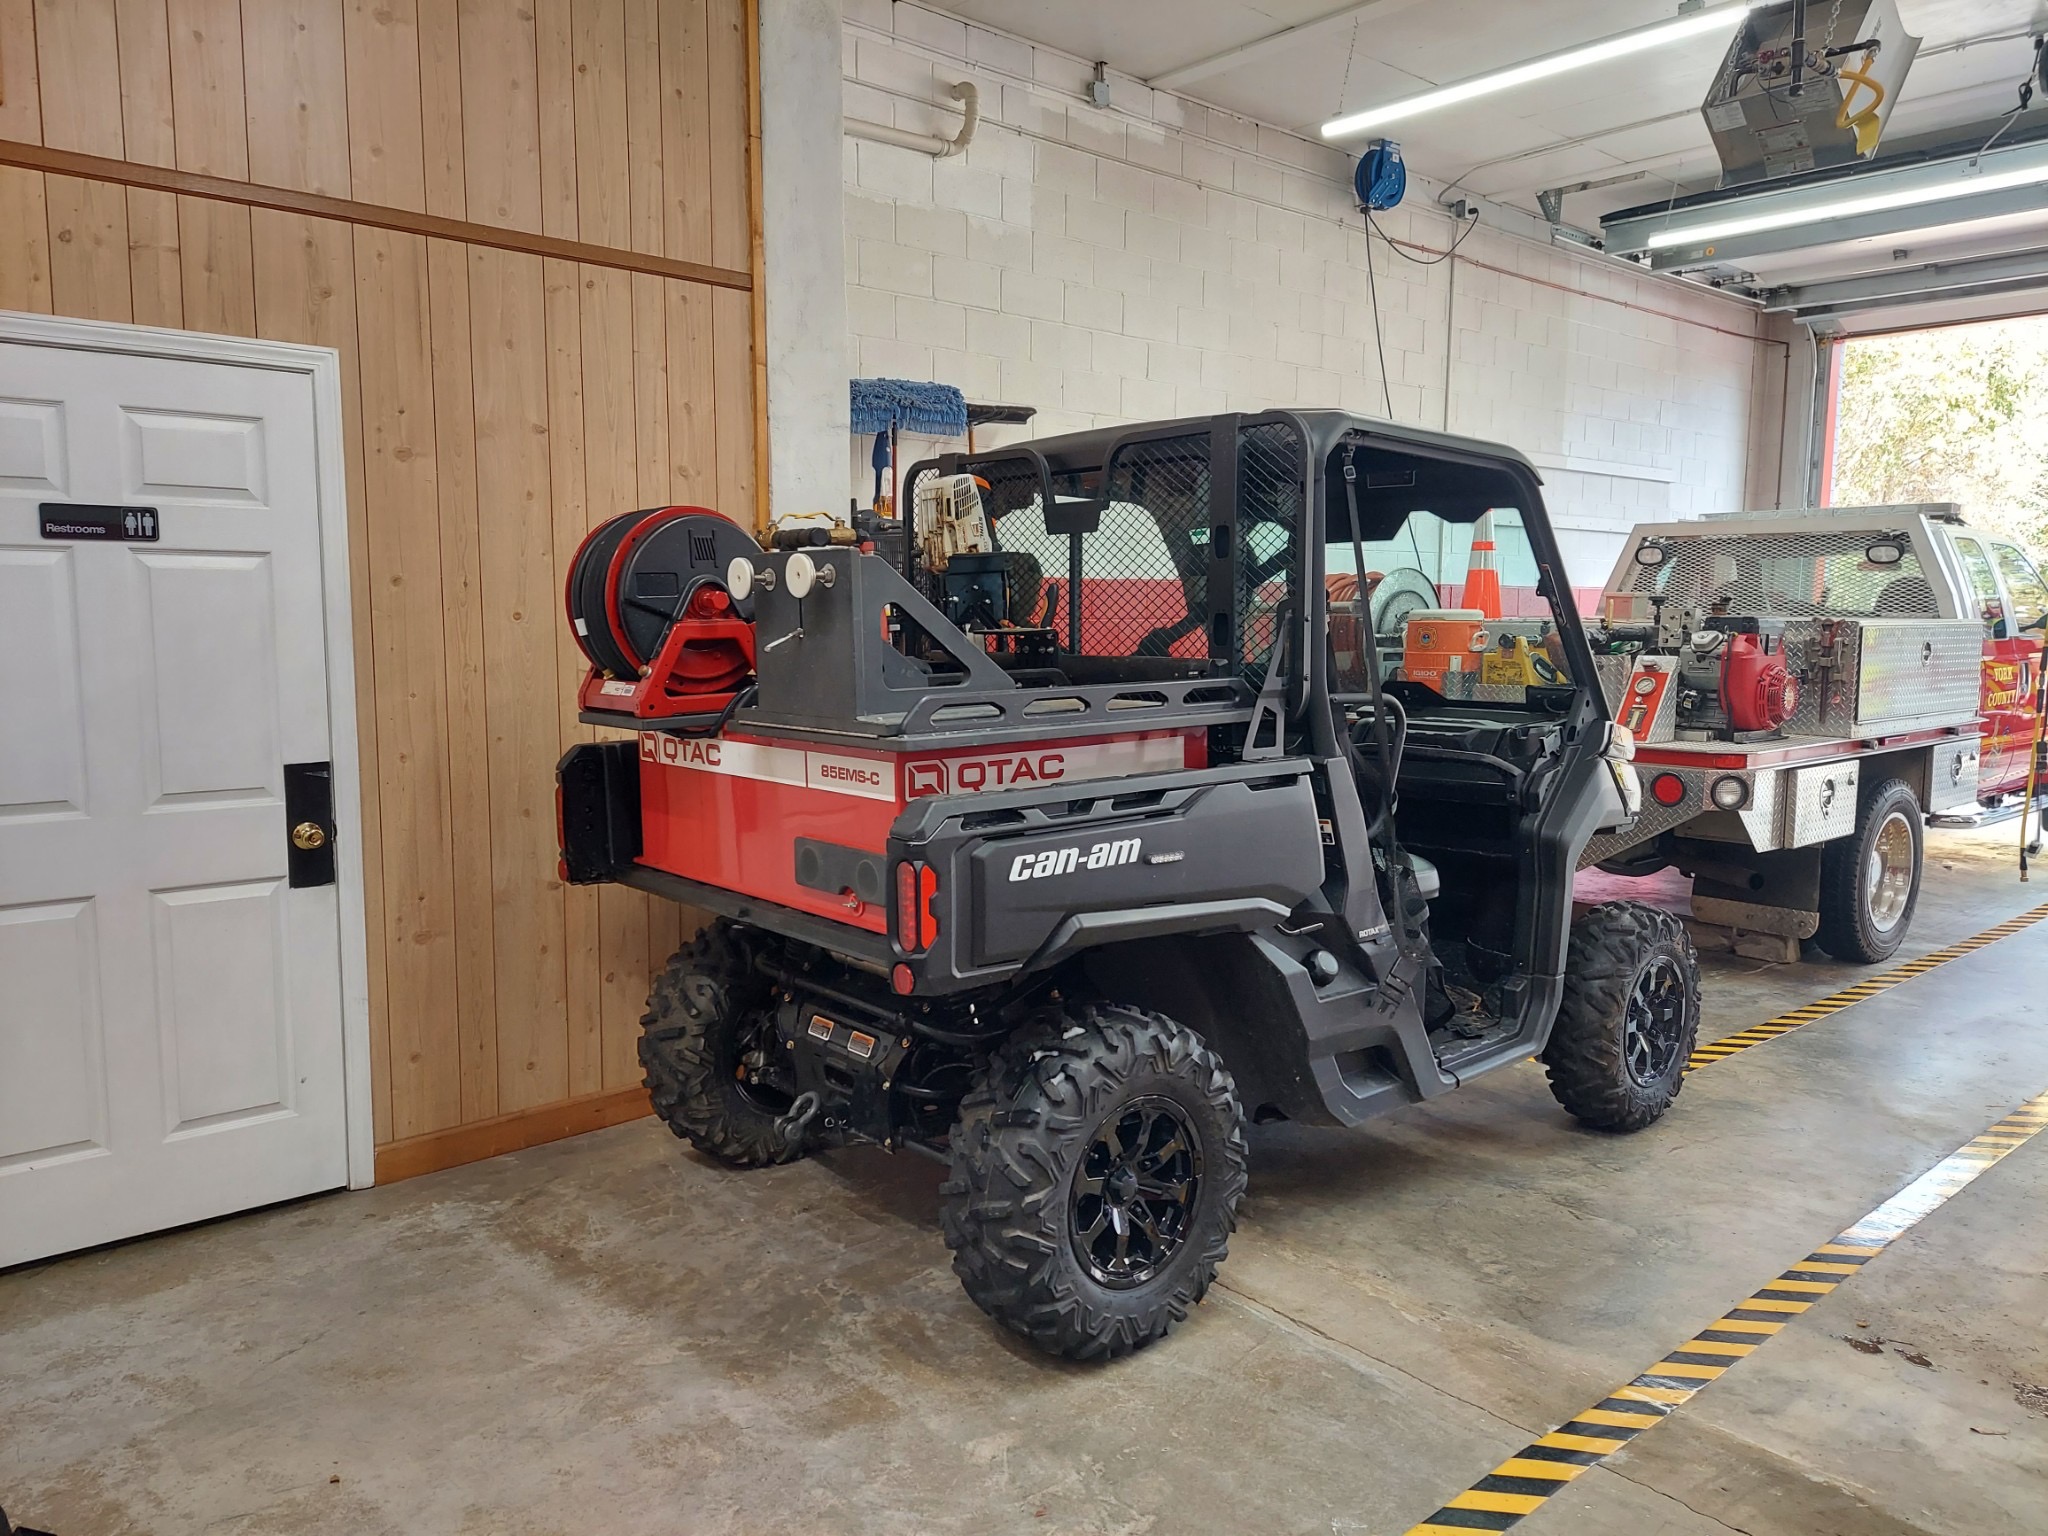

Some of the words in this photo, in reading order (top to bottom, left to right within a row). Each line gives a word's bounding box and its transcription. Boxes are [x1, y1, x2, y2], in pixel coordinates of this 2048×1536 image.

[46, 523, 106, 535] Restrooms
[1993, 666, 2014, 682] YORK
[1987, 689, 2016, 707] COUNTY
[663, 738, 721, 766] QTAC
[821, 764, 880, 786] 85EMS-C
[957, 754, 1065, 792] QTAC
[1008, 837, 1143, 882] can-am
[1358, 927, 1380, 939] ROTAX
